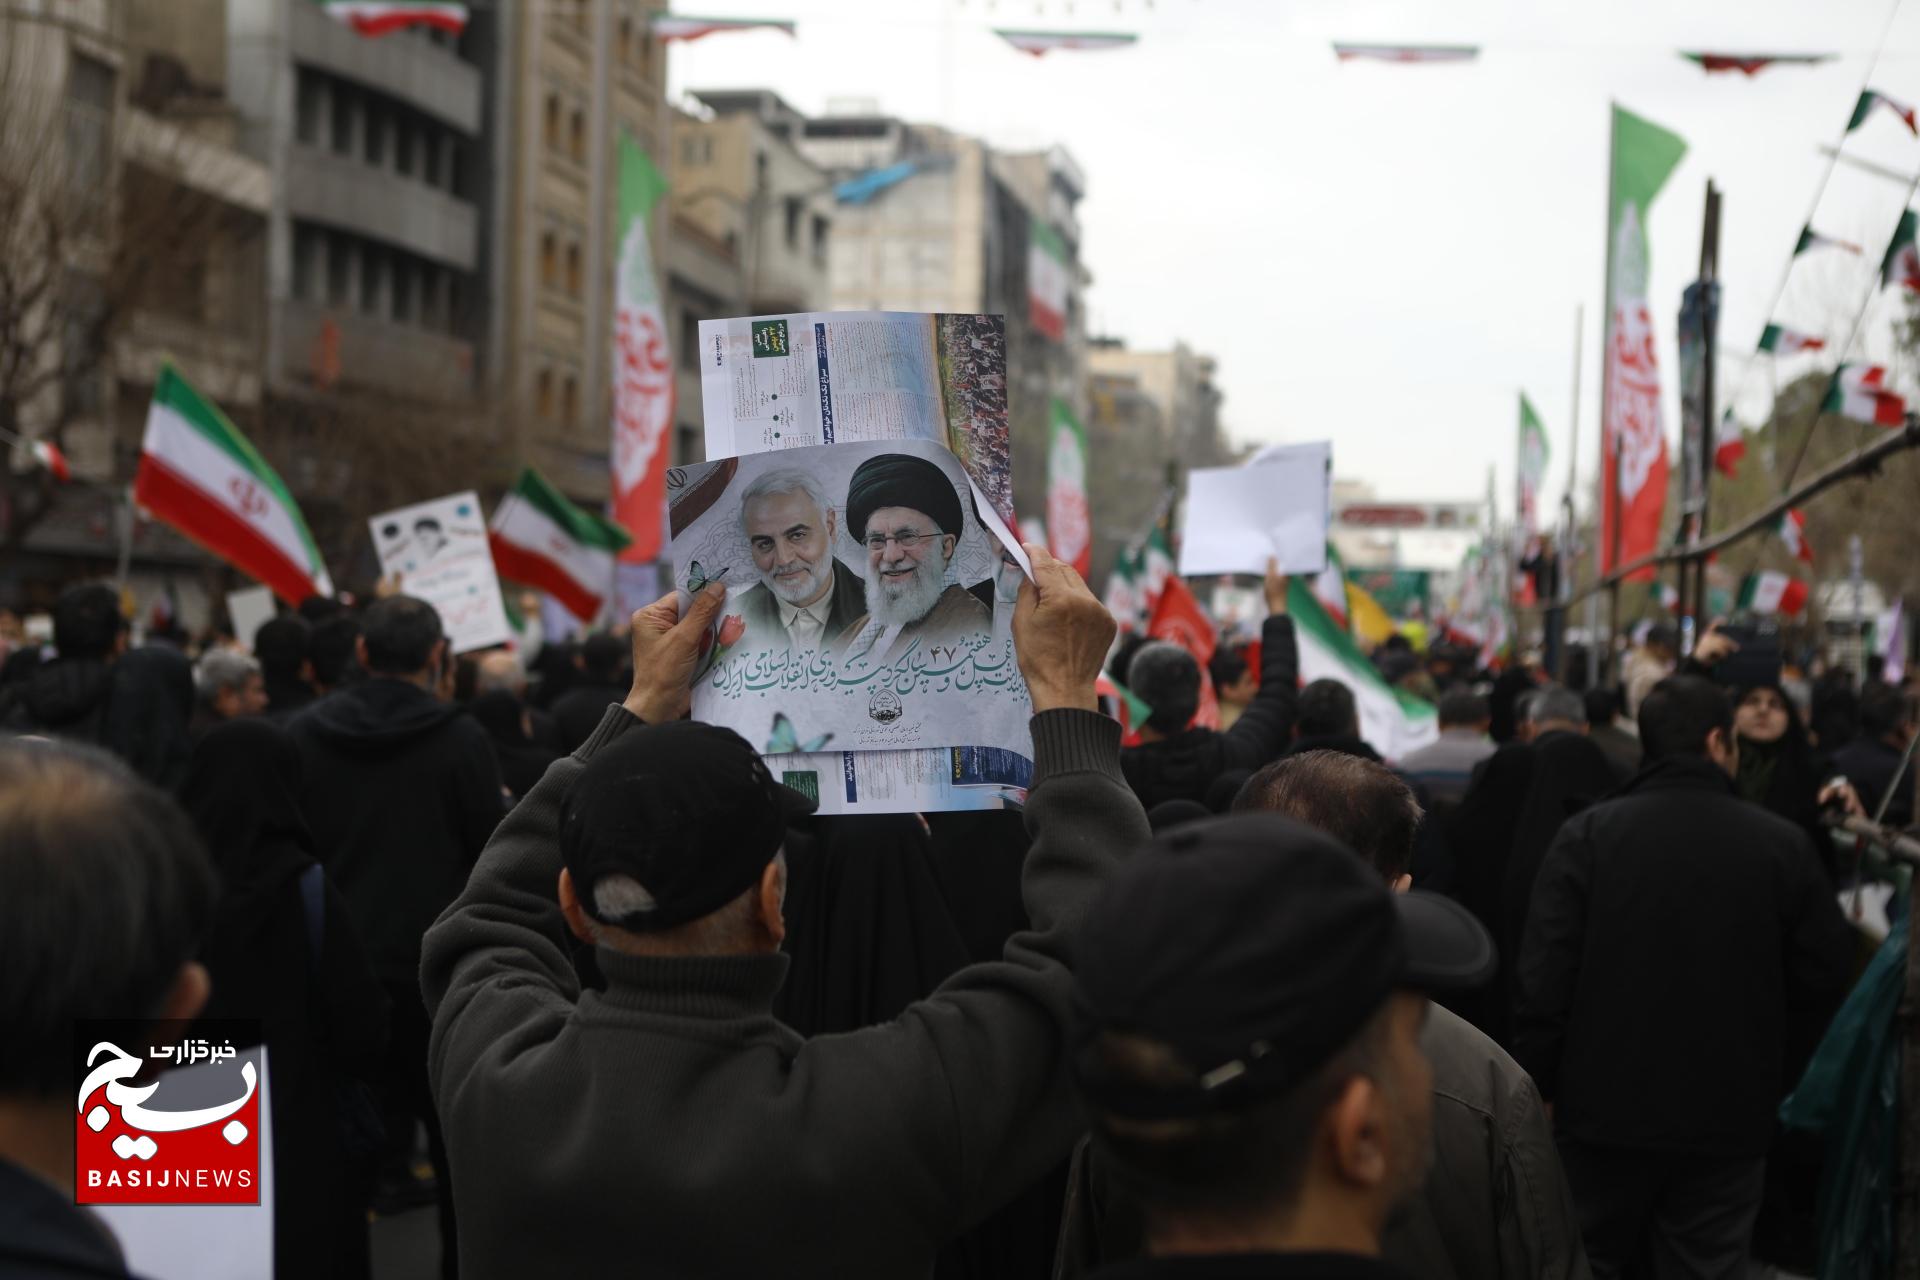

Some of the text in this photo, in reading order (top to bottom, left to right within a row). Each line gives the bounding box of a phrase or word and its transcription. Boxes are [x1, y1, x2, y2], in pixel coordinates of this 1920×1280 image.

[819, 368, 830, 384] سراغ
[820, 384, 829, 395] تک
[823, 417, 833, 439] خواهیم
[740, 648, 790, 681] اسلامی
[928, 645, 957, 665] ۴۷
[712, 658, 744, 699] ایران
[744, 654, 809, 698] انقلاب
[808, 648, 887, 697] پیروزی
